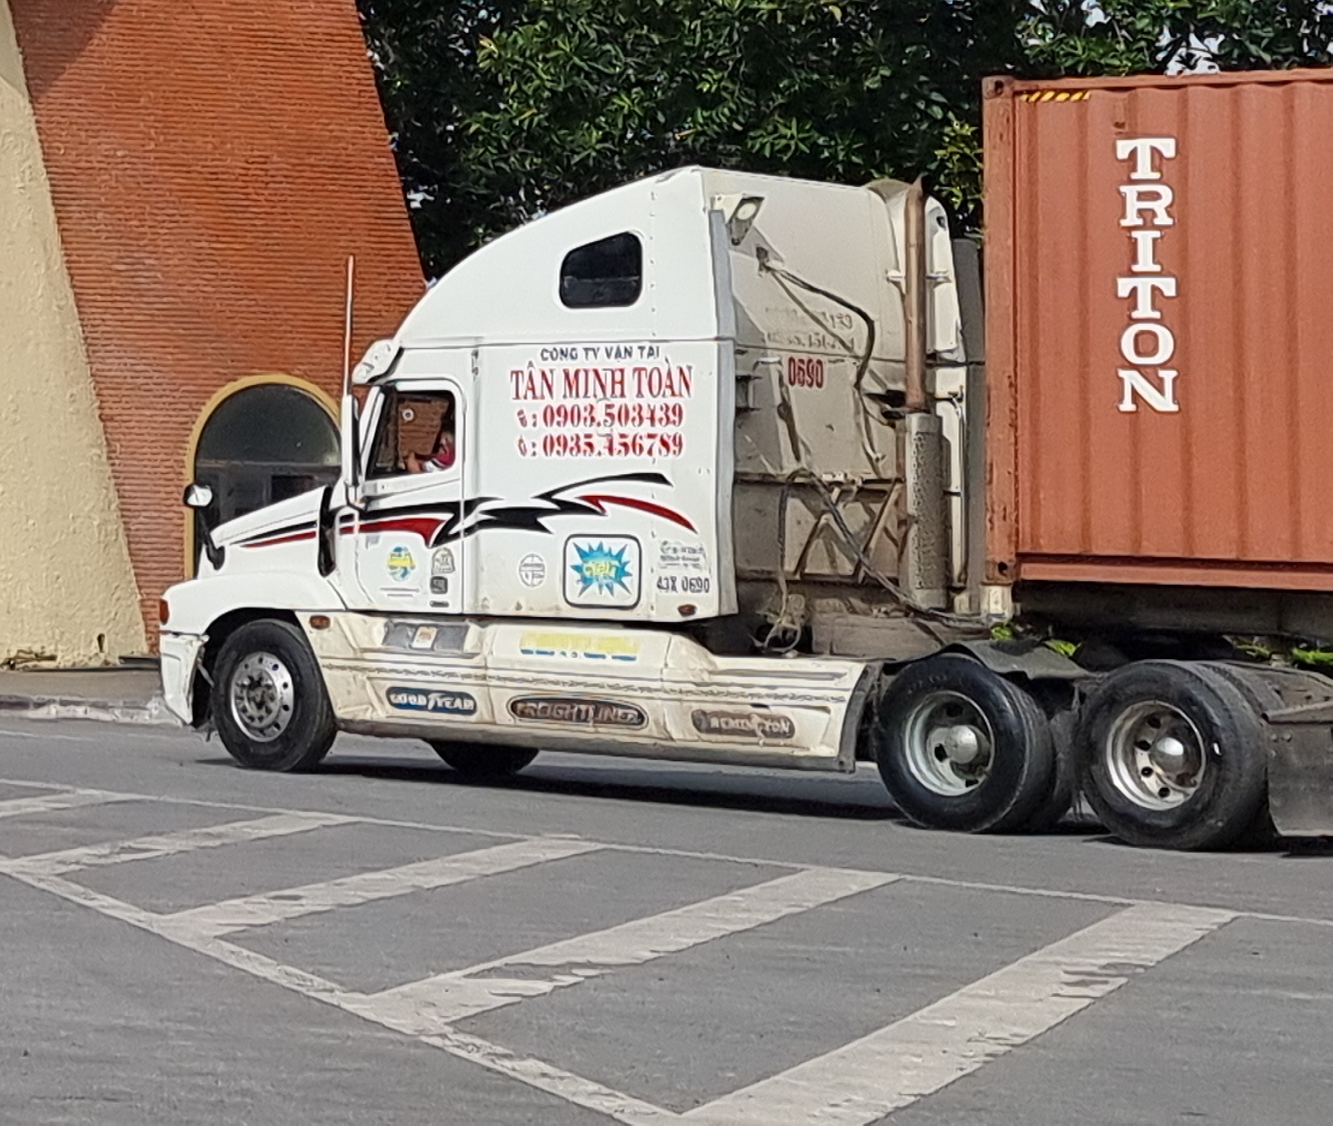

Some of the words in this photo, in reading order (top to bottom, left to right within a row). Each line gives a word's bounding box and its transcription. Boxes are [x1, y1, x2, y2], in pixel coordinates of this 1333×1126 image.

[1115, 136, 1180, 413] TRITON
[582, 347, 601, 361] TY
[510, 360, 556, 401] TÂN
[562, 367, 627, 400] MINH
[632, 355, 694, 400] TOÀN
[787, 356, 824, 389] 0690
[542, 431, 684, 457] 0935.456789
